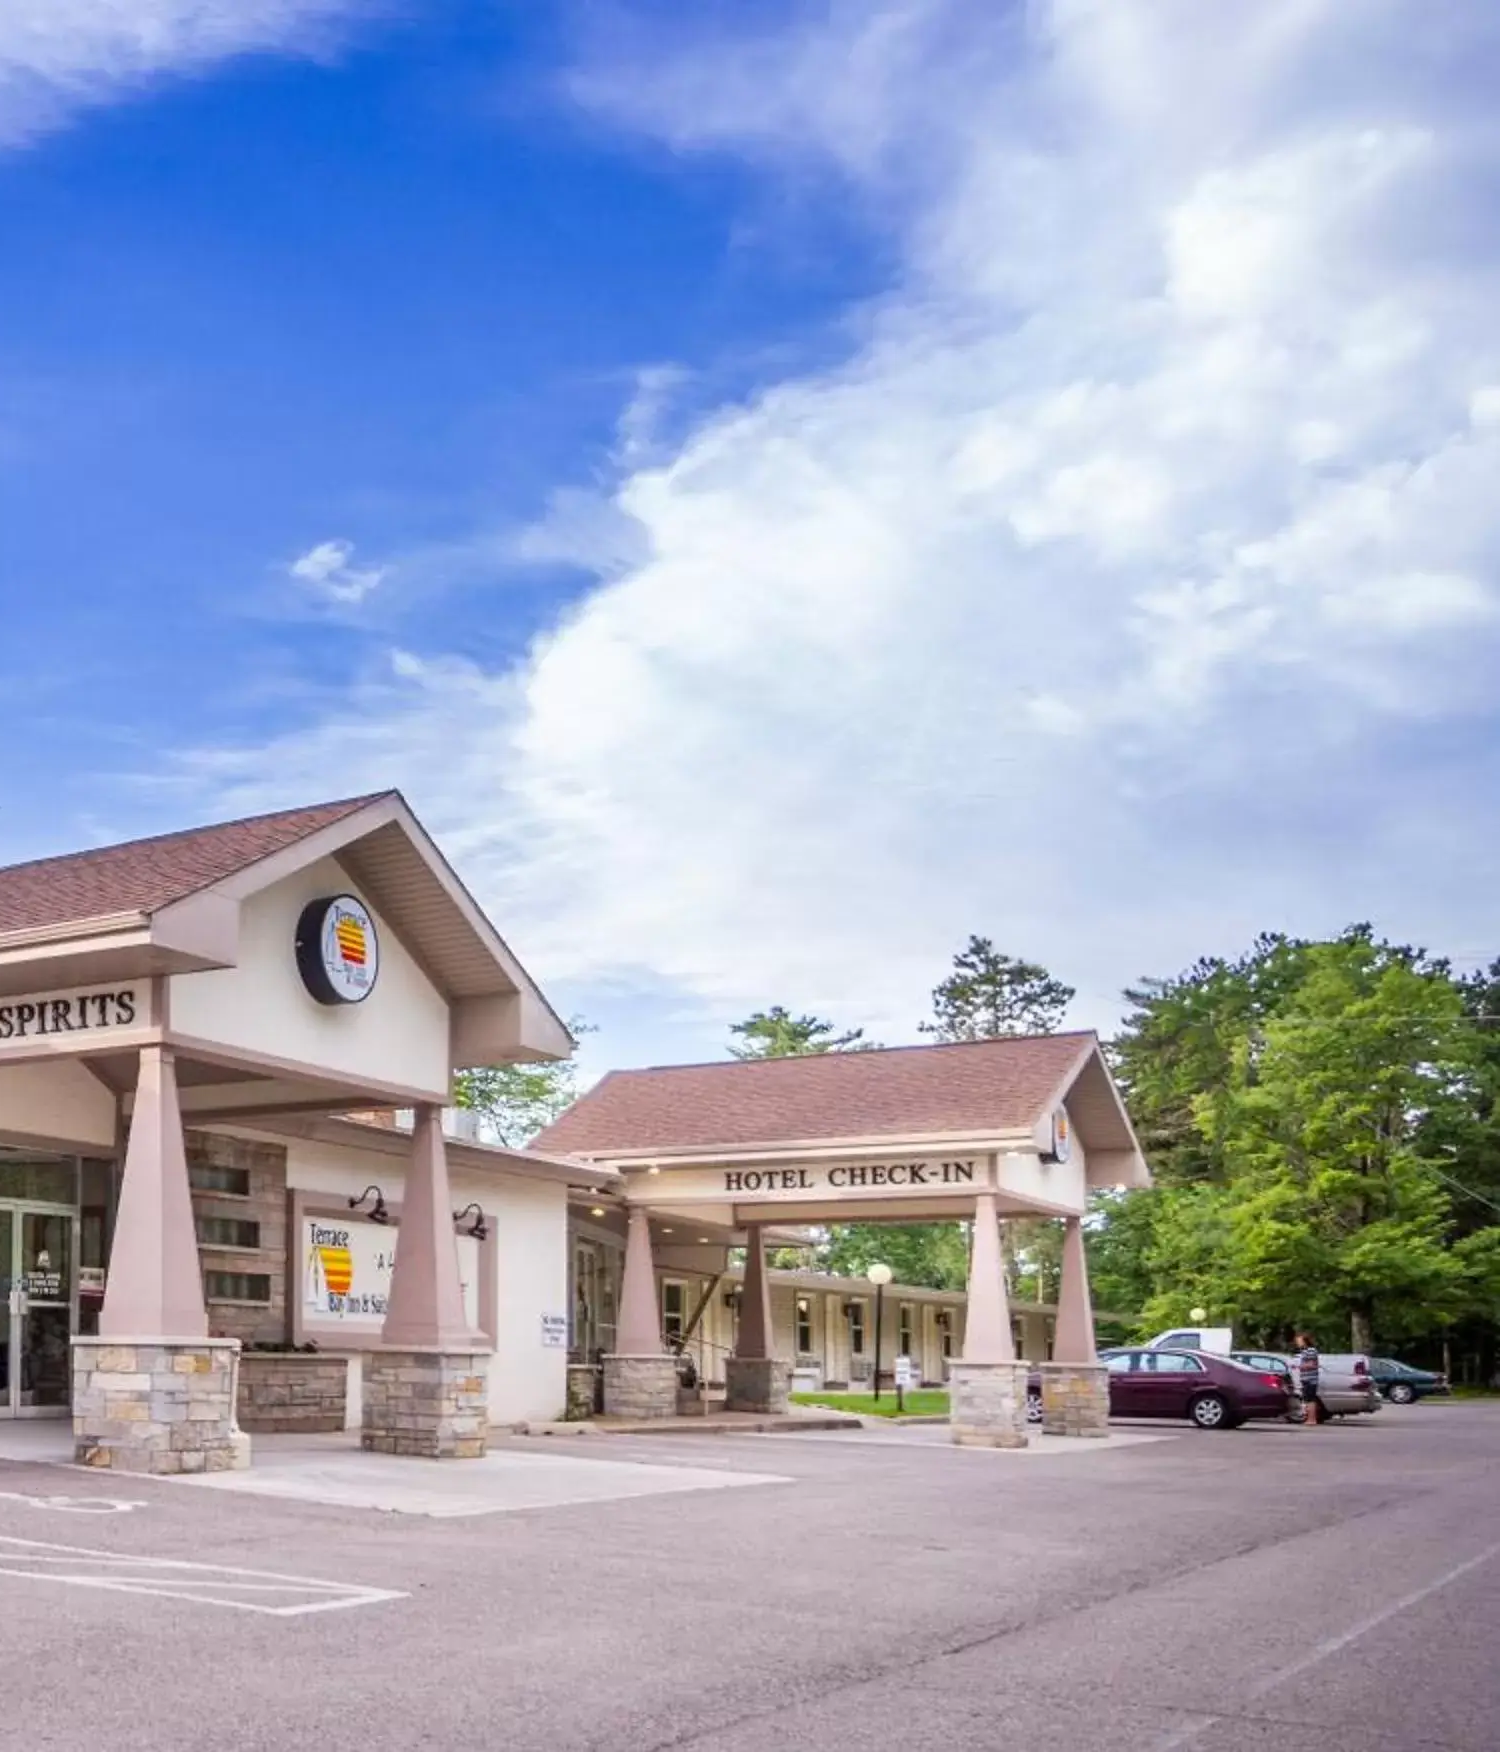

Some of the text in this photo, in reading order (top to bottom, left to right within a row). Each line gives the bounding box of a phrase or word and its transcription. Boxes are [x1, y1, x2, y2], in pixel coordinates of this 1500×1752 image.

[723, 1161, 976, 1191] HOTEL CHECK-IN
[309, 1223, 349, 1247] Terrace
